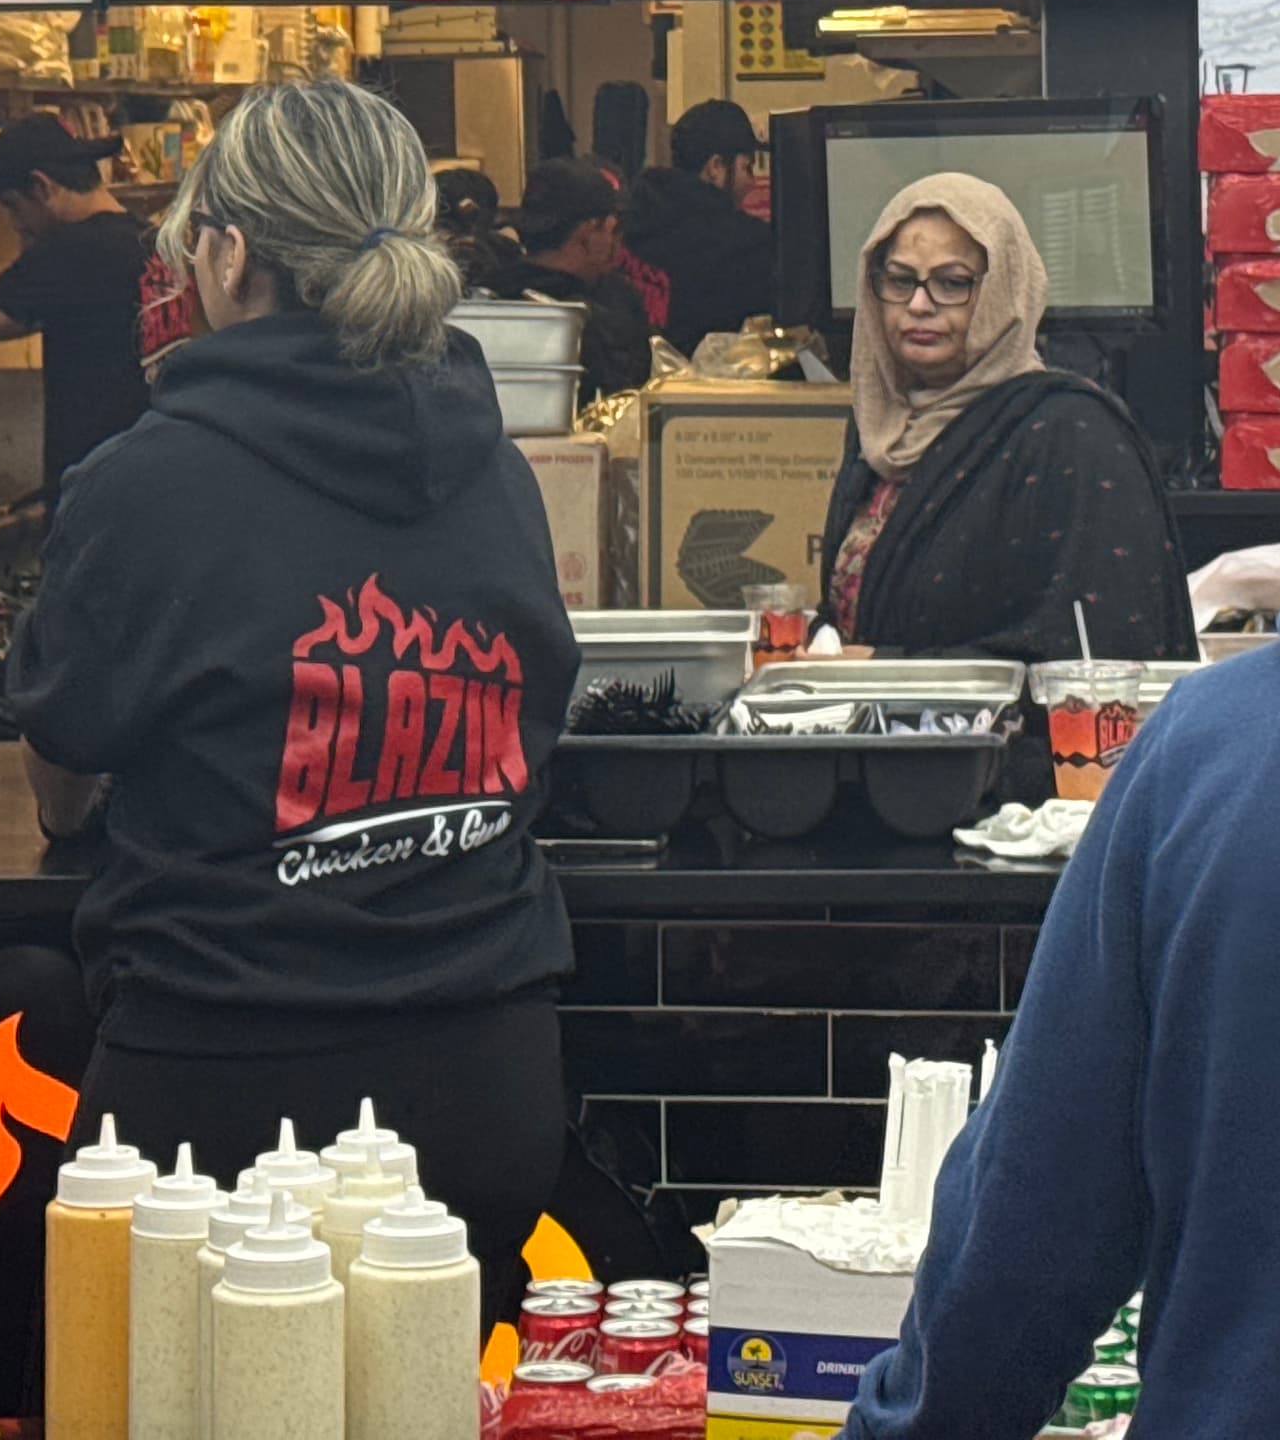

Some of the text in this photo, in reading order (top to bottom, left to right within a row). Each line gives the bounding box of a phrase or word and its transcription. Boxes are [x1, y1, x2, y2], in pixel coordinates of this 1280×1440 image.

[274, 661, 529, 833] BLAZIN
[277, 832, 418, 887] Chicken
[421, 813, 454, 857] &
[734, 1371, 780, 1387] SUNSET
